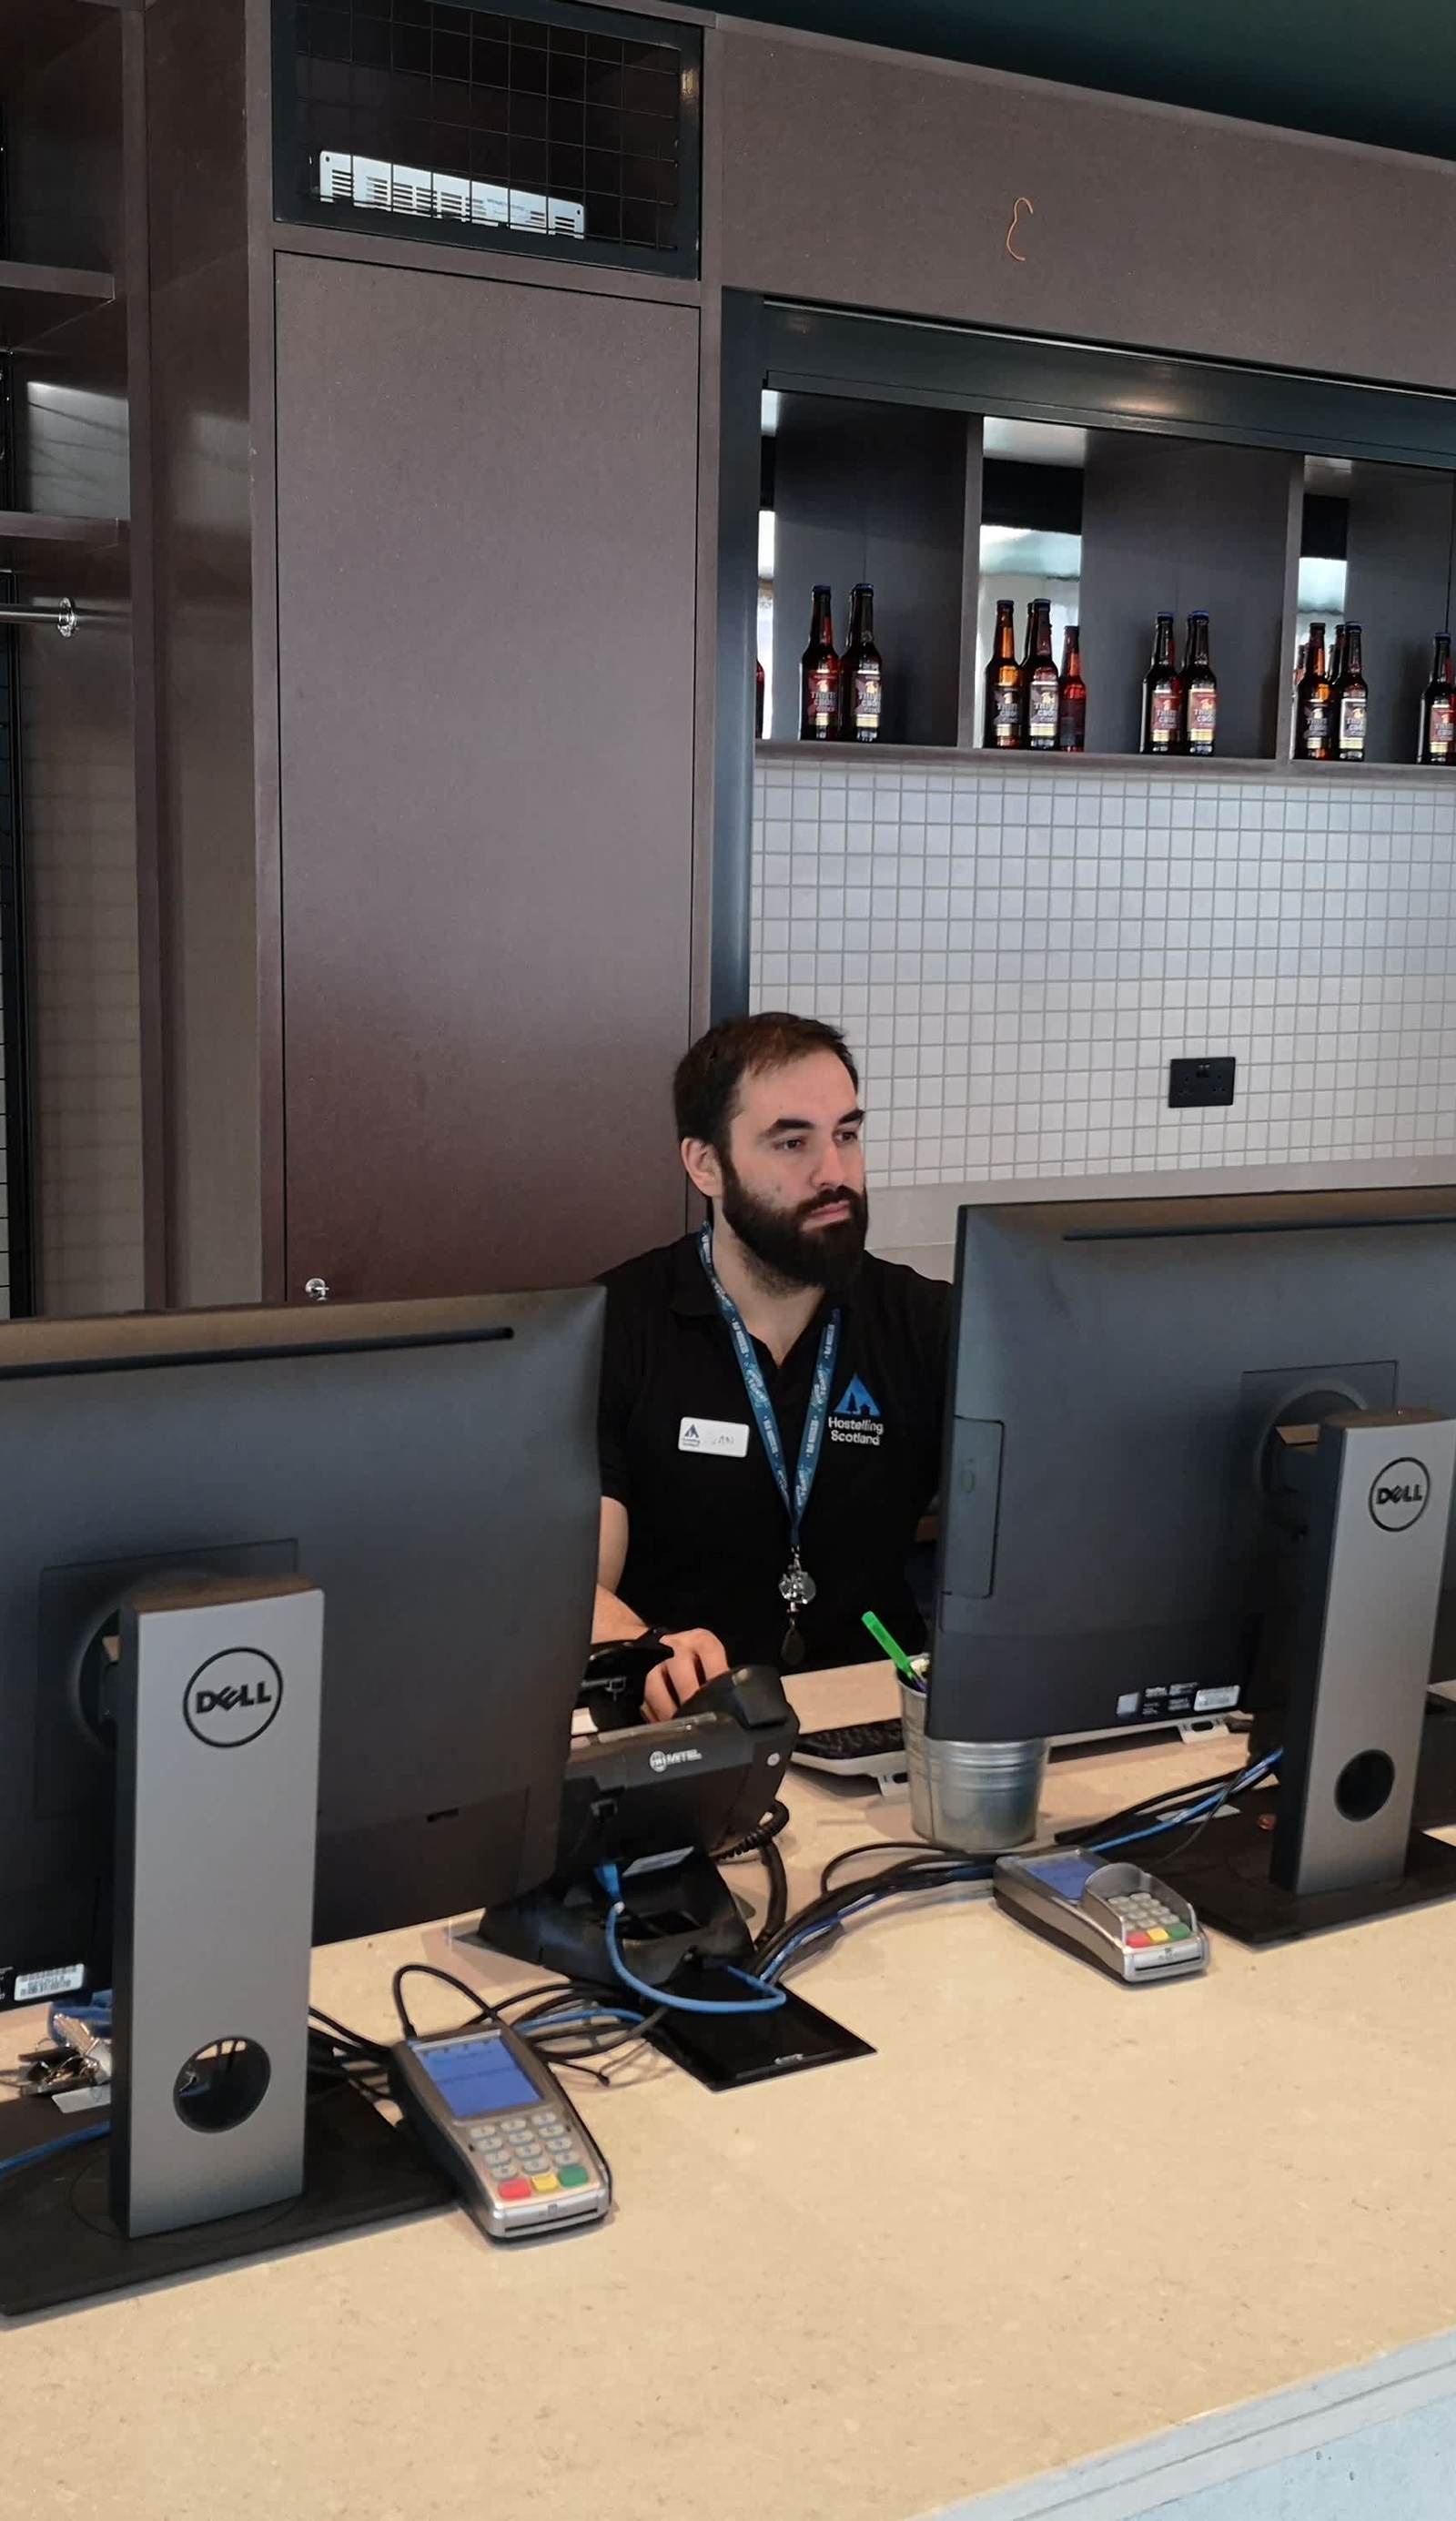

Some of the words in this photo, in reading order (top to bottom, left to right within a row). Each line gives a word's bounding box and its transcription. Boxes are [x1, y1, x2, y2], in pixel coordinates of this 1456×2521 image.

[828, 1416, 884, 1434] Hostelling
[831, 1430, 880, 1445] Scotland
[1376, 1483, 1422, 1504] DELL
[196, 1681, 272, 1714] DELL
